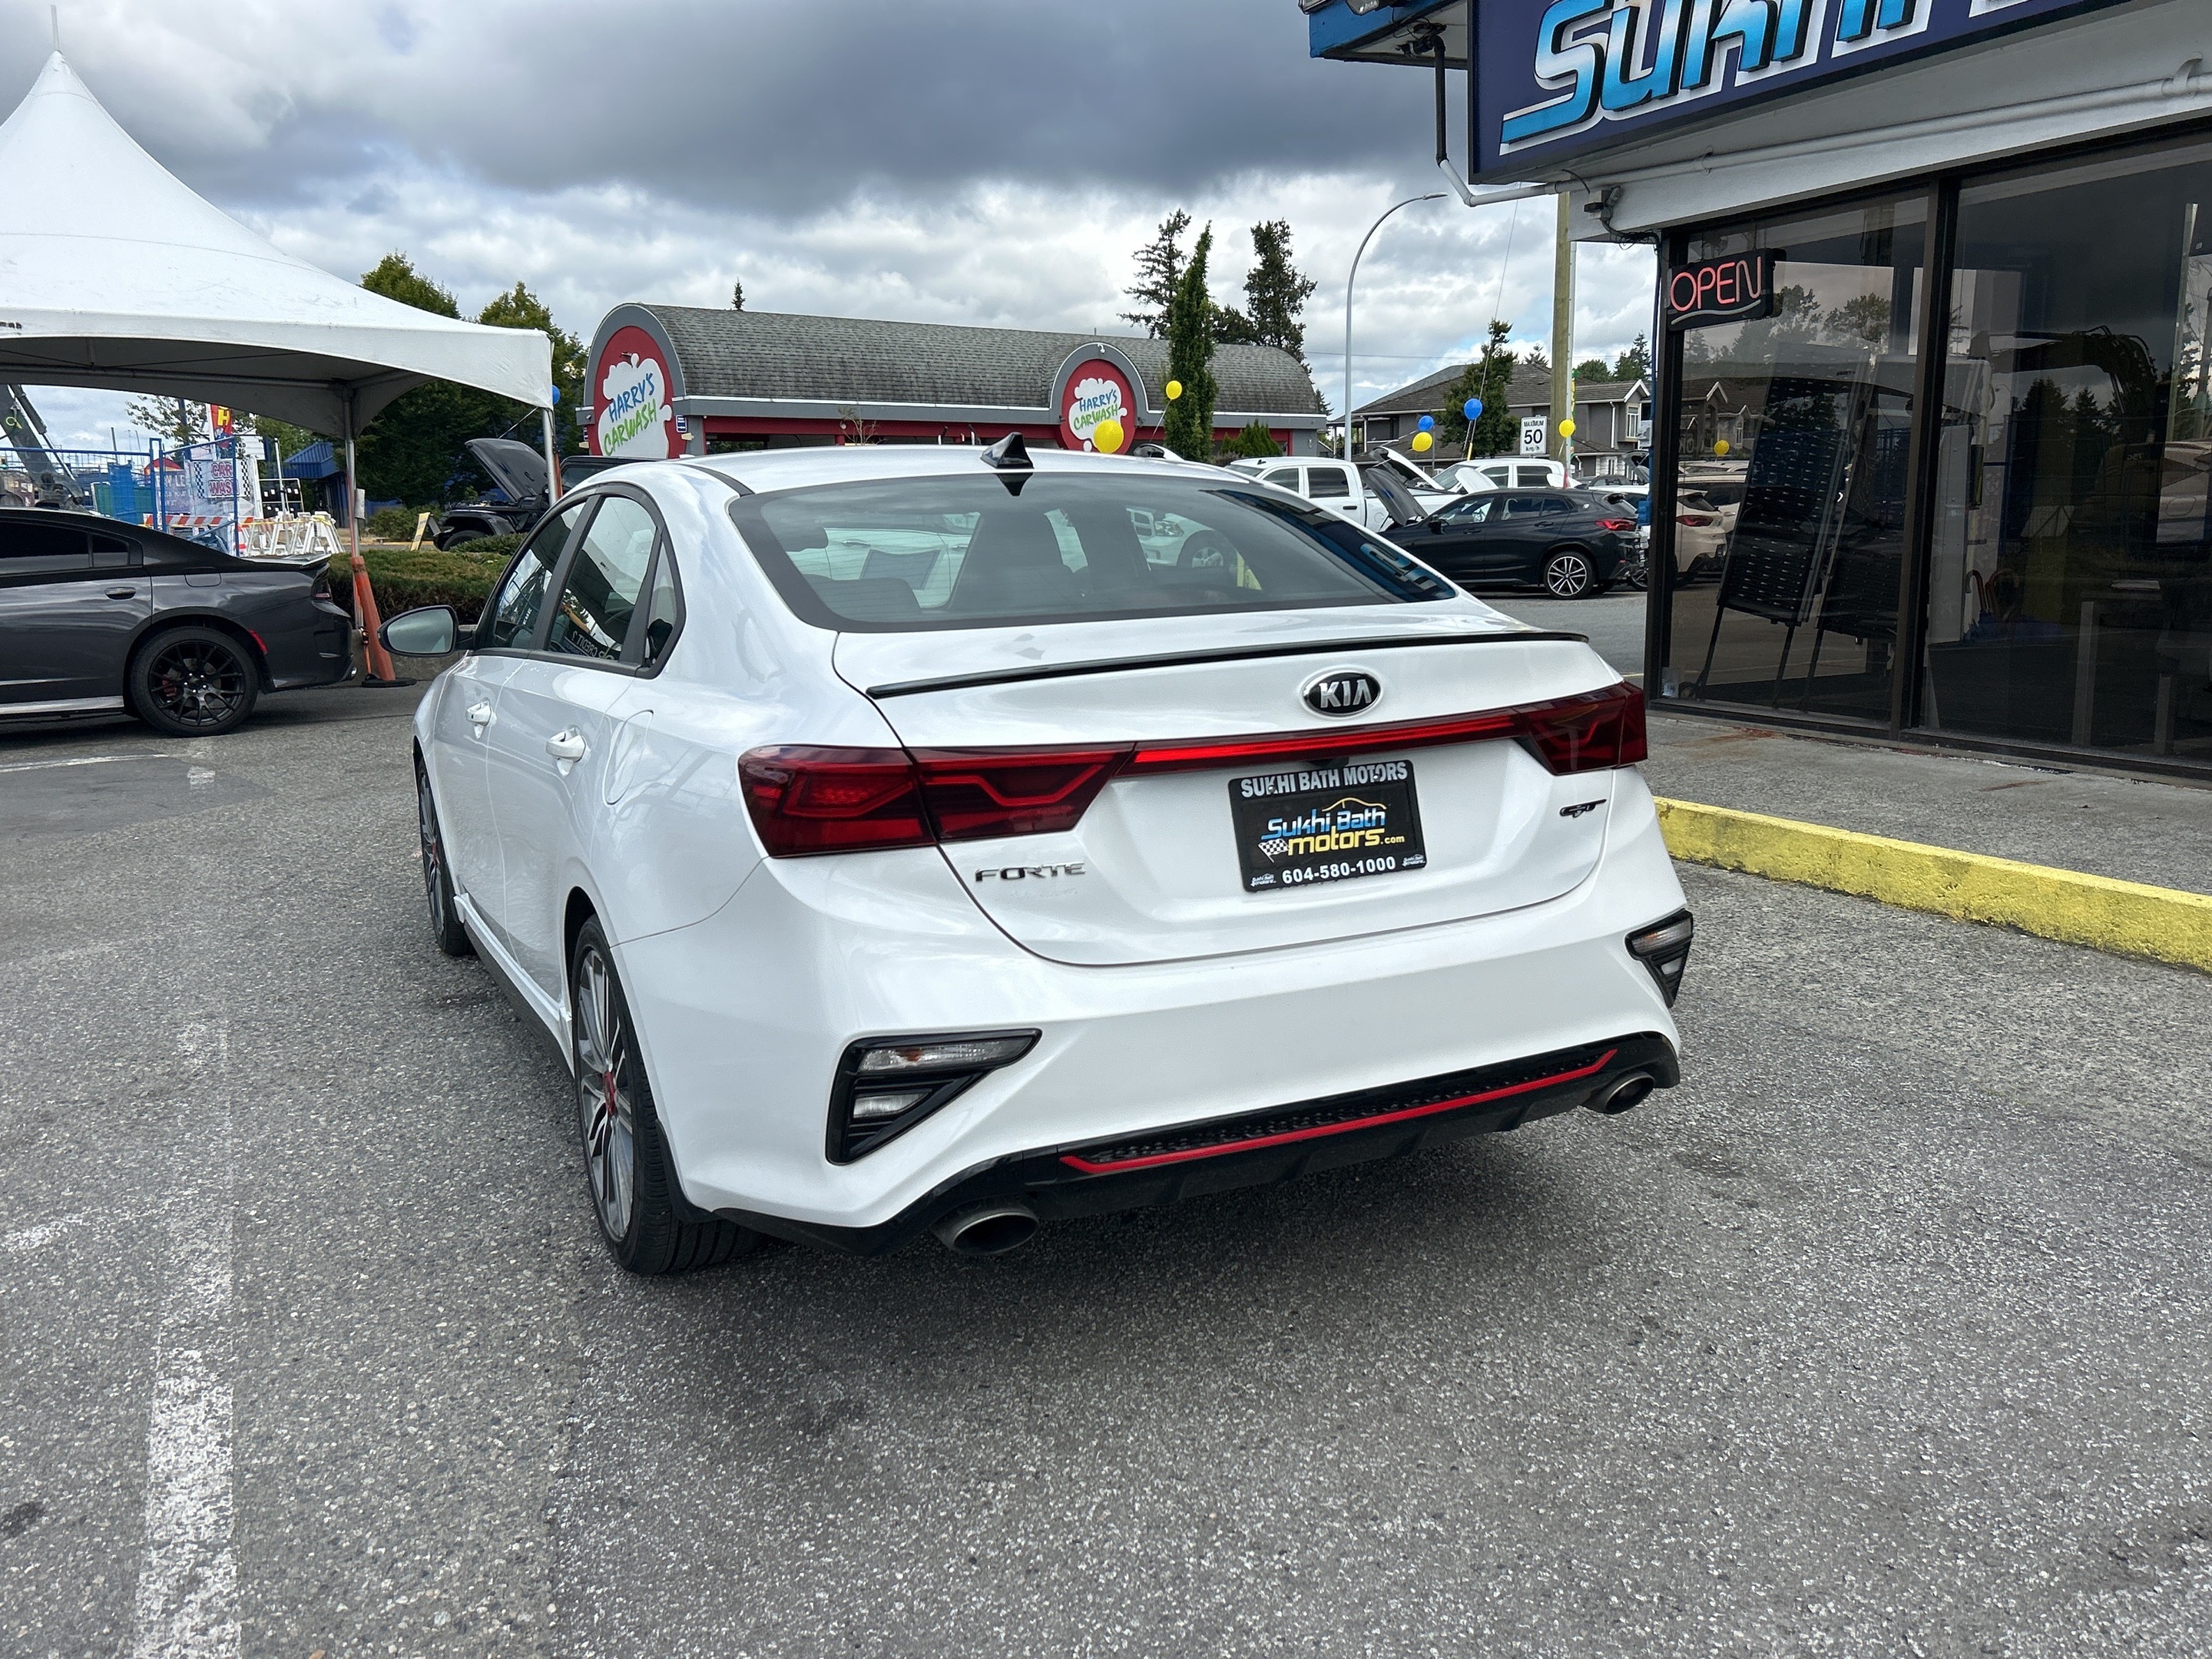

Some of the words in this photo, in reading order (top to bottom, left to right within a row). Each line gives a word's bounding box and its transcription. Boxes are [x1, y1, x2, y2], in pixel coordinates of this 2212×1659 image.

[1670, 256, 1763, 312] OPEN
[608, 373, 655, 422] HARRY'S
[1079, 389, 1118, 412] HARRY'S
[604, 399, 657, 455] CARWASH
[1074, 404, 1118, 430] CARWASH
[1524, 429, 1543, 444] 50
[211, 462, 233, 478] CAR
[1319, 679, 1373, 708] KIA
[1240, 773, 1296, 797] SUKHI
[1300, 768, 1340, 791] BATH
[1343, 762, 1408, 786] MOTORS
[1260, 809, 1331, 840] Sukhi
[1337, 807, 1386, 830] Bath
[975, 862, 1085, 882] FORTE
[1282, 856, 1396, 884] 604-580-1000
